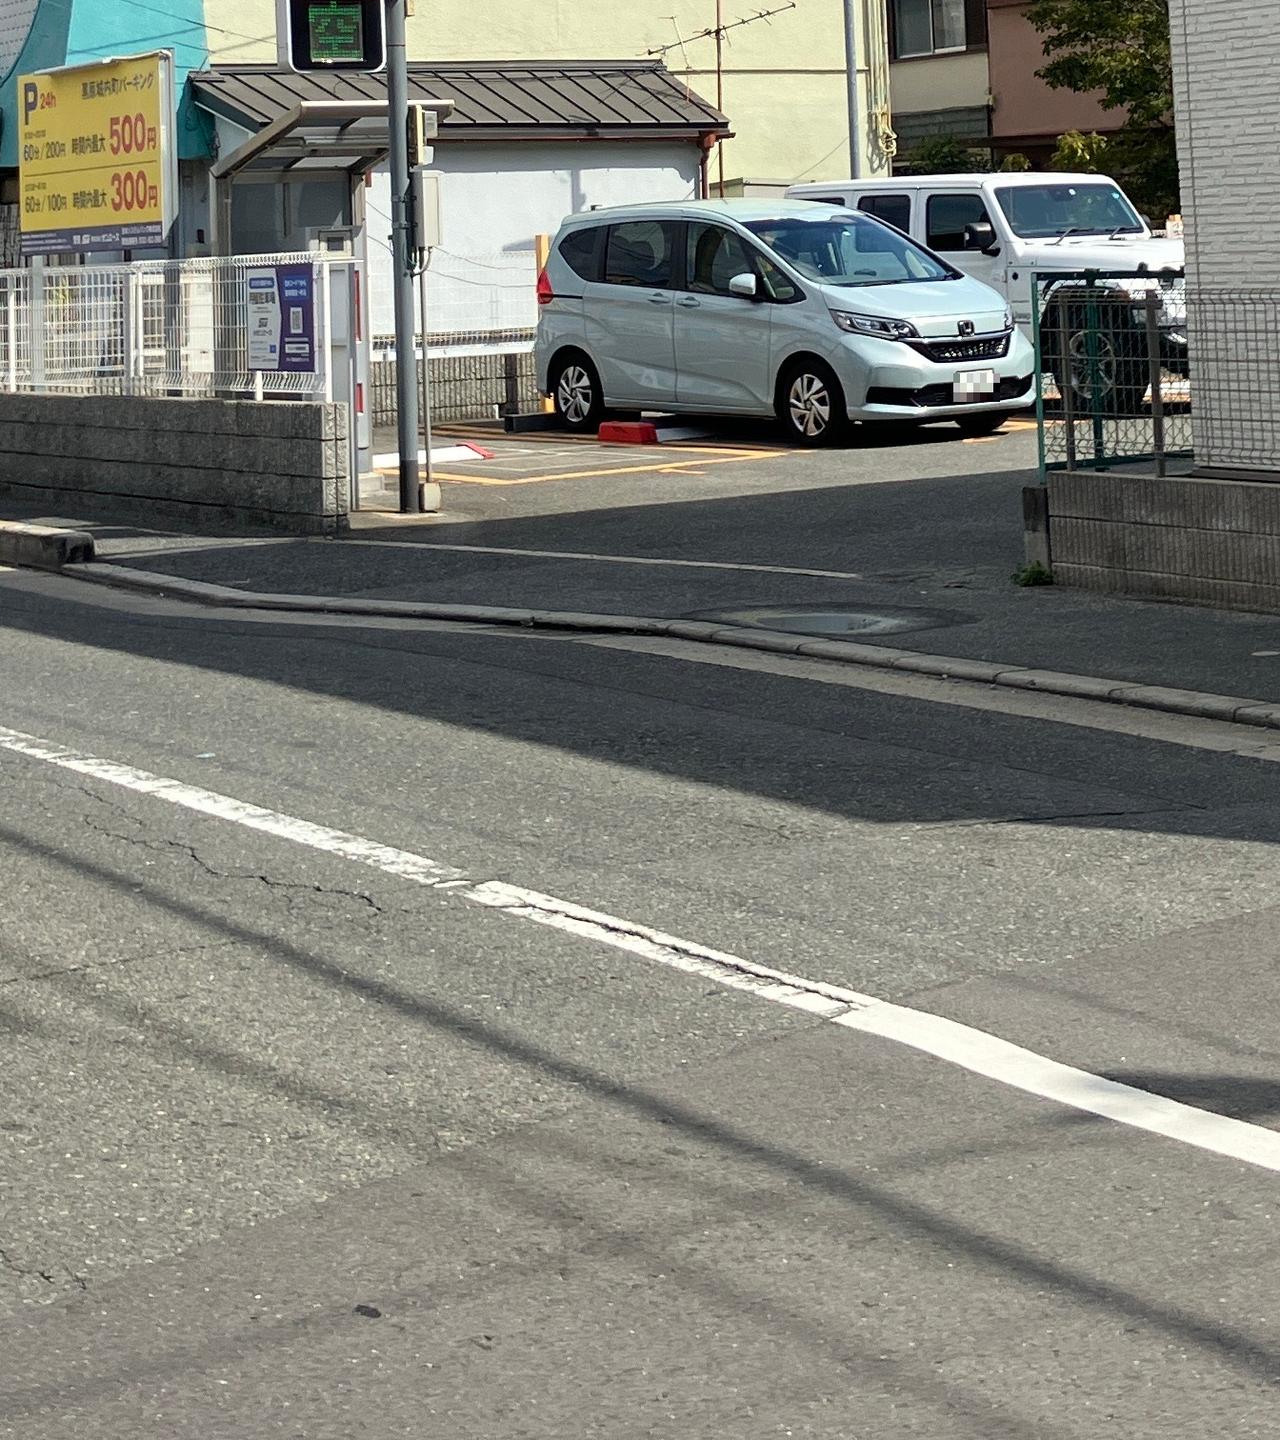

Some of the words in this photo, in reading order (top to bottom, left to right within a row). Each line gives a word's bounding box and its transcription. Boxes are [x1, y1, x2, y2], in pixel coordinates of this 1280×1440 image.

[24, 82, 38, 125] P
[40, 92, 57, 110] 24h
[110, 112, 157, 156] 500円
[111, 170, 158, 212] 300円
